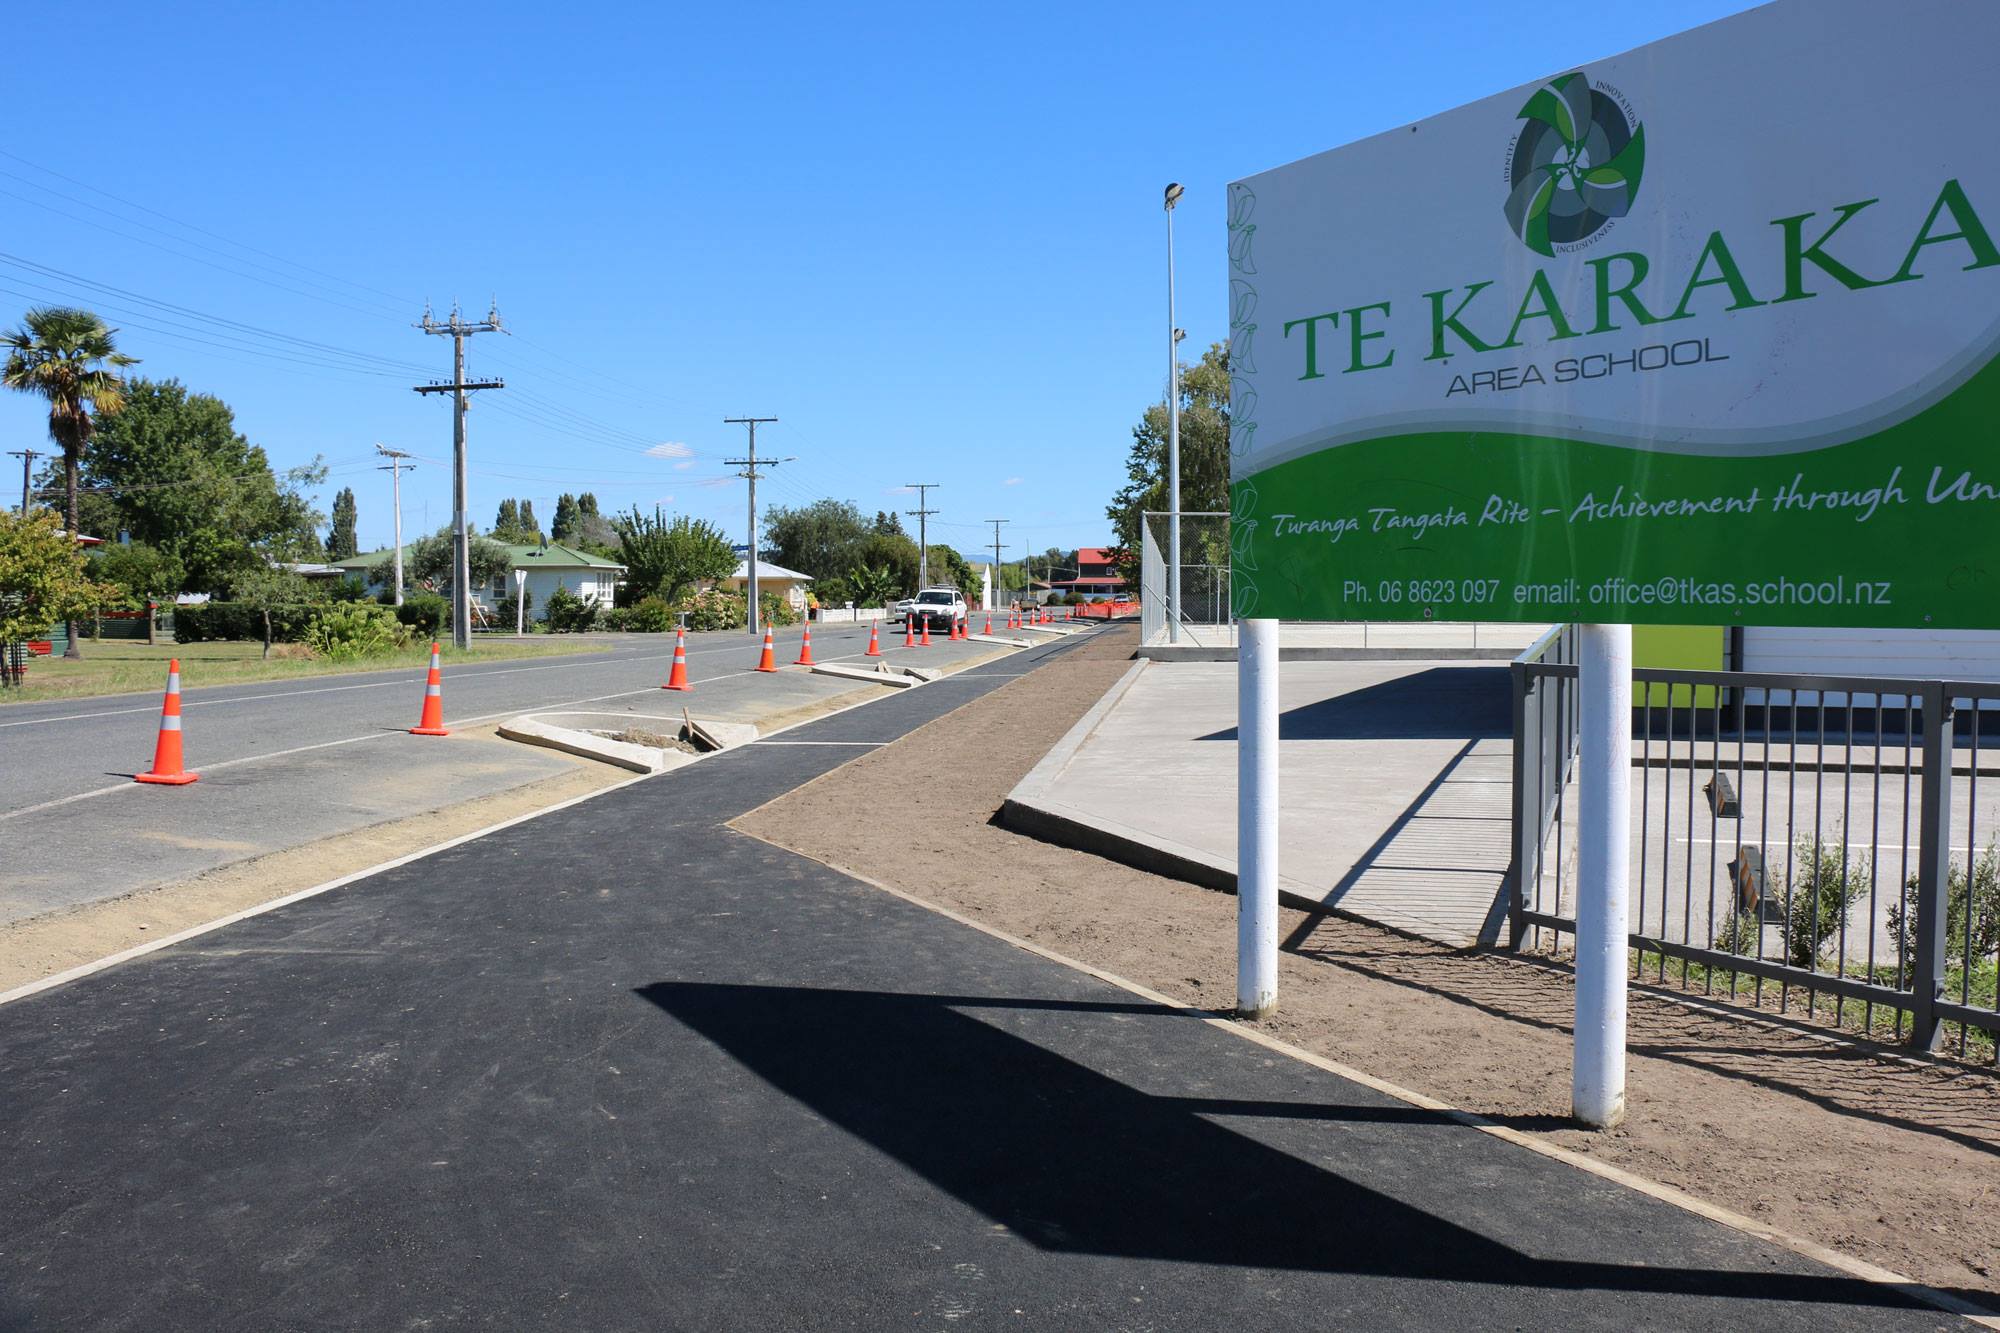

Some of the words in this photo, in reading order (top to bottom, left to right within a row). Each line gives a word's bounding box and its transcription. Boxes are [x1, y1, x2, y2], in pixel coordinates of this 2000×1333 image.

[1596, 80, 1637, 128] INNOVATION
[1503, 135, 1517, 183] IDENTITY
[1556, 221, 1615, 253] INCLUSIVENESS
[1284, 302, 1395, 381] TE
[1423, 178, 2000, 361] KARAKA
[1445, 364, 1546, 398] AREA
[1554, 338, 1730, 384] SCHOOL
[1271, 514, 1360, 543] Turanga
[1368, 506, 1468, 540] Tangata
[1478, 494, 1530, 527] Rite
[1569, 485, 1763, 522] Achievement
[1773, 466, 1909, 522] through
[1925, 466, 2000, 504] Un
[1343, 580, 1372, 603] Ph.
[1379, 580, 1402, 603] 06
[1408, 580, 1456, 603] 8623
[1462, 579, 1500, 603] 097
[1513, 578, 1581, 604] email:
[1588, 575, 1892, 606] office@tkas.school.nz
